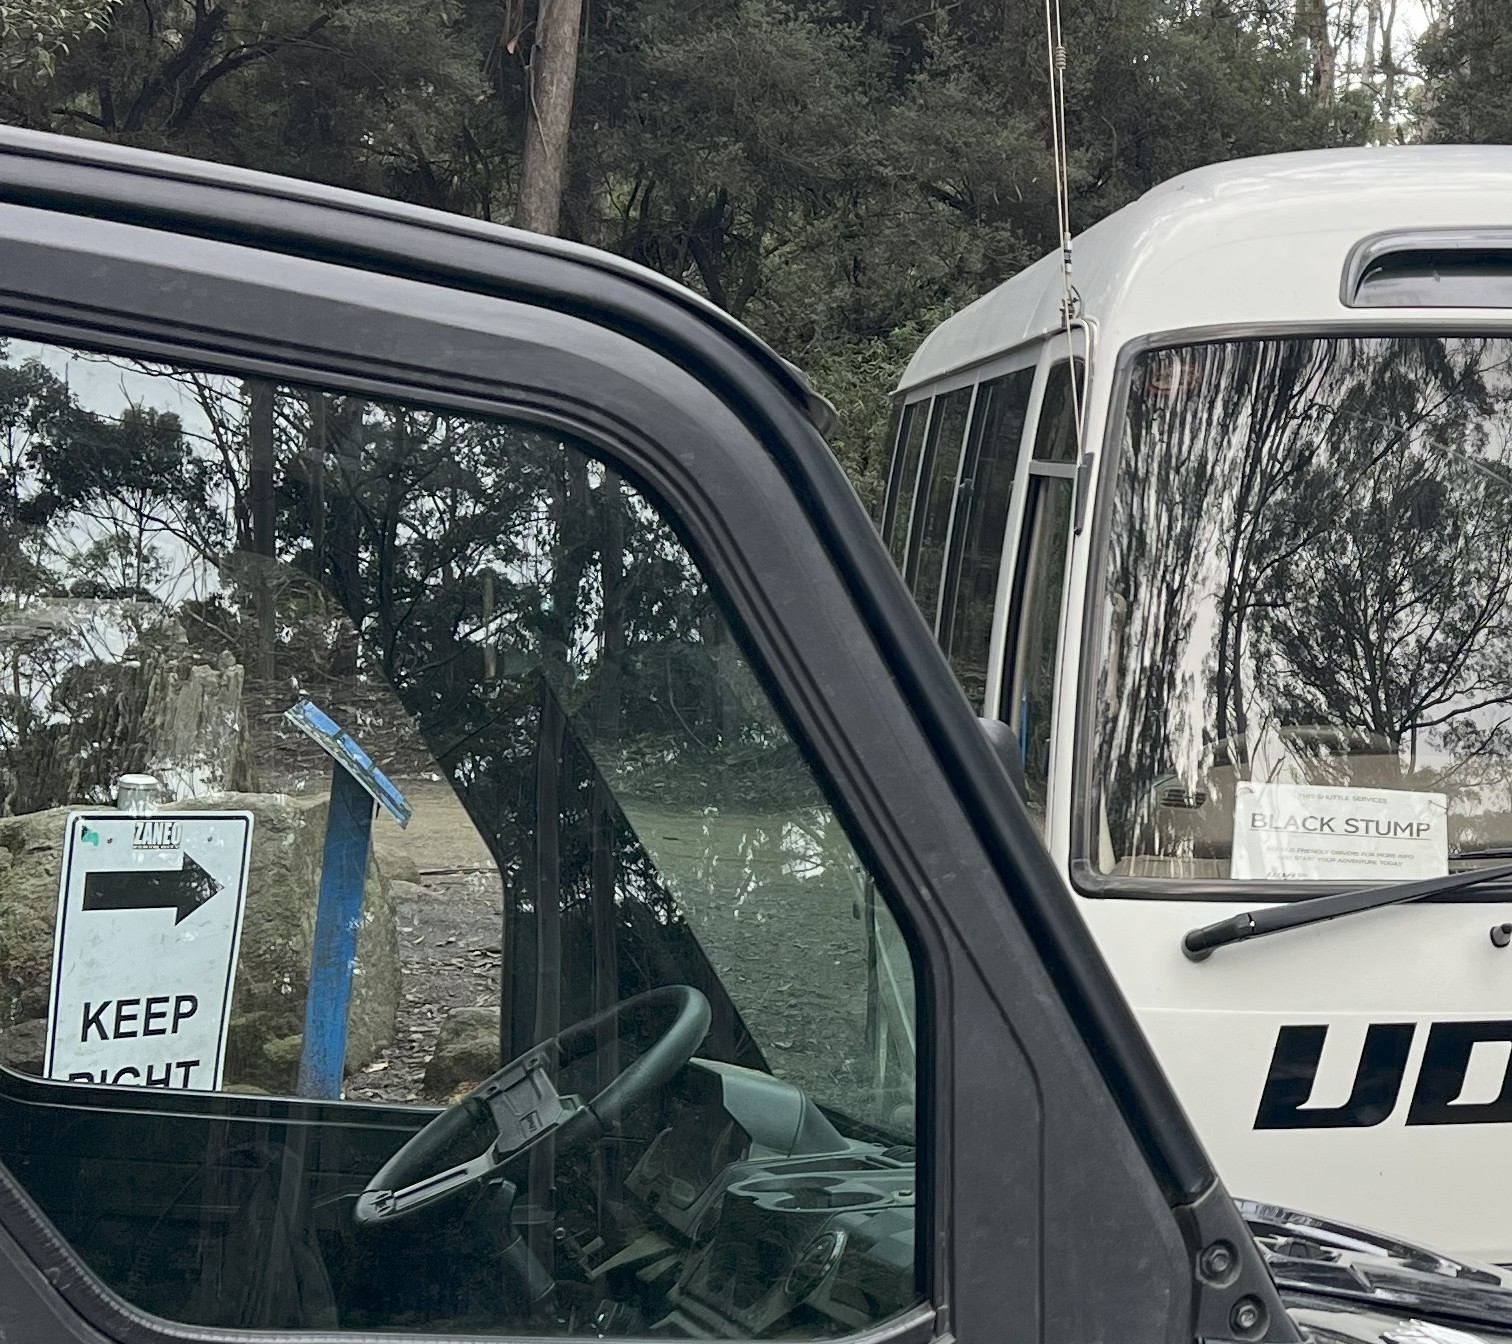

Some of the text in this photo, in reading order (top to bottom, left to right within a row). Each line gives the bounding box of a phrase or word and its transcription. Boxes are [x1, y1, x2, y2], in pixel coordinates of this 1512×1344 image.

[1352, 795, 1388, 805] SERVICES
[1251, 812, 1431, 838] BLACK STUMP
[1338, 858, 1378, 867] ADVENTURE
[1380, 860, 1404, 868] TODAY
[80, 994, 199, 1042] KEEP
